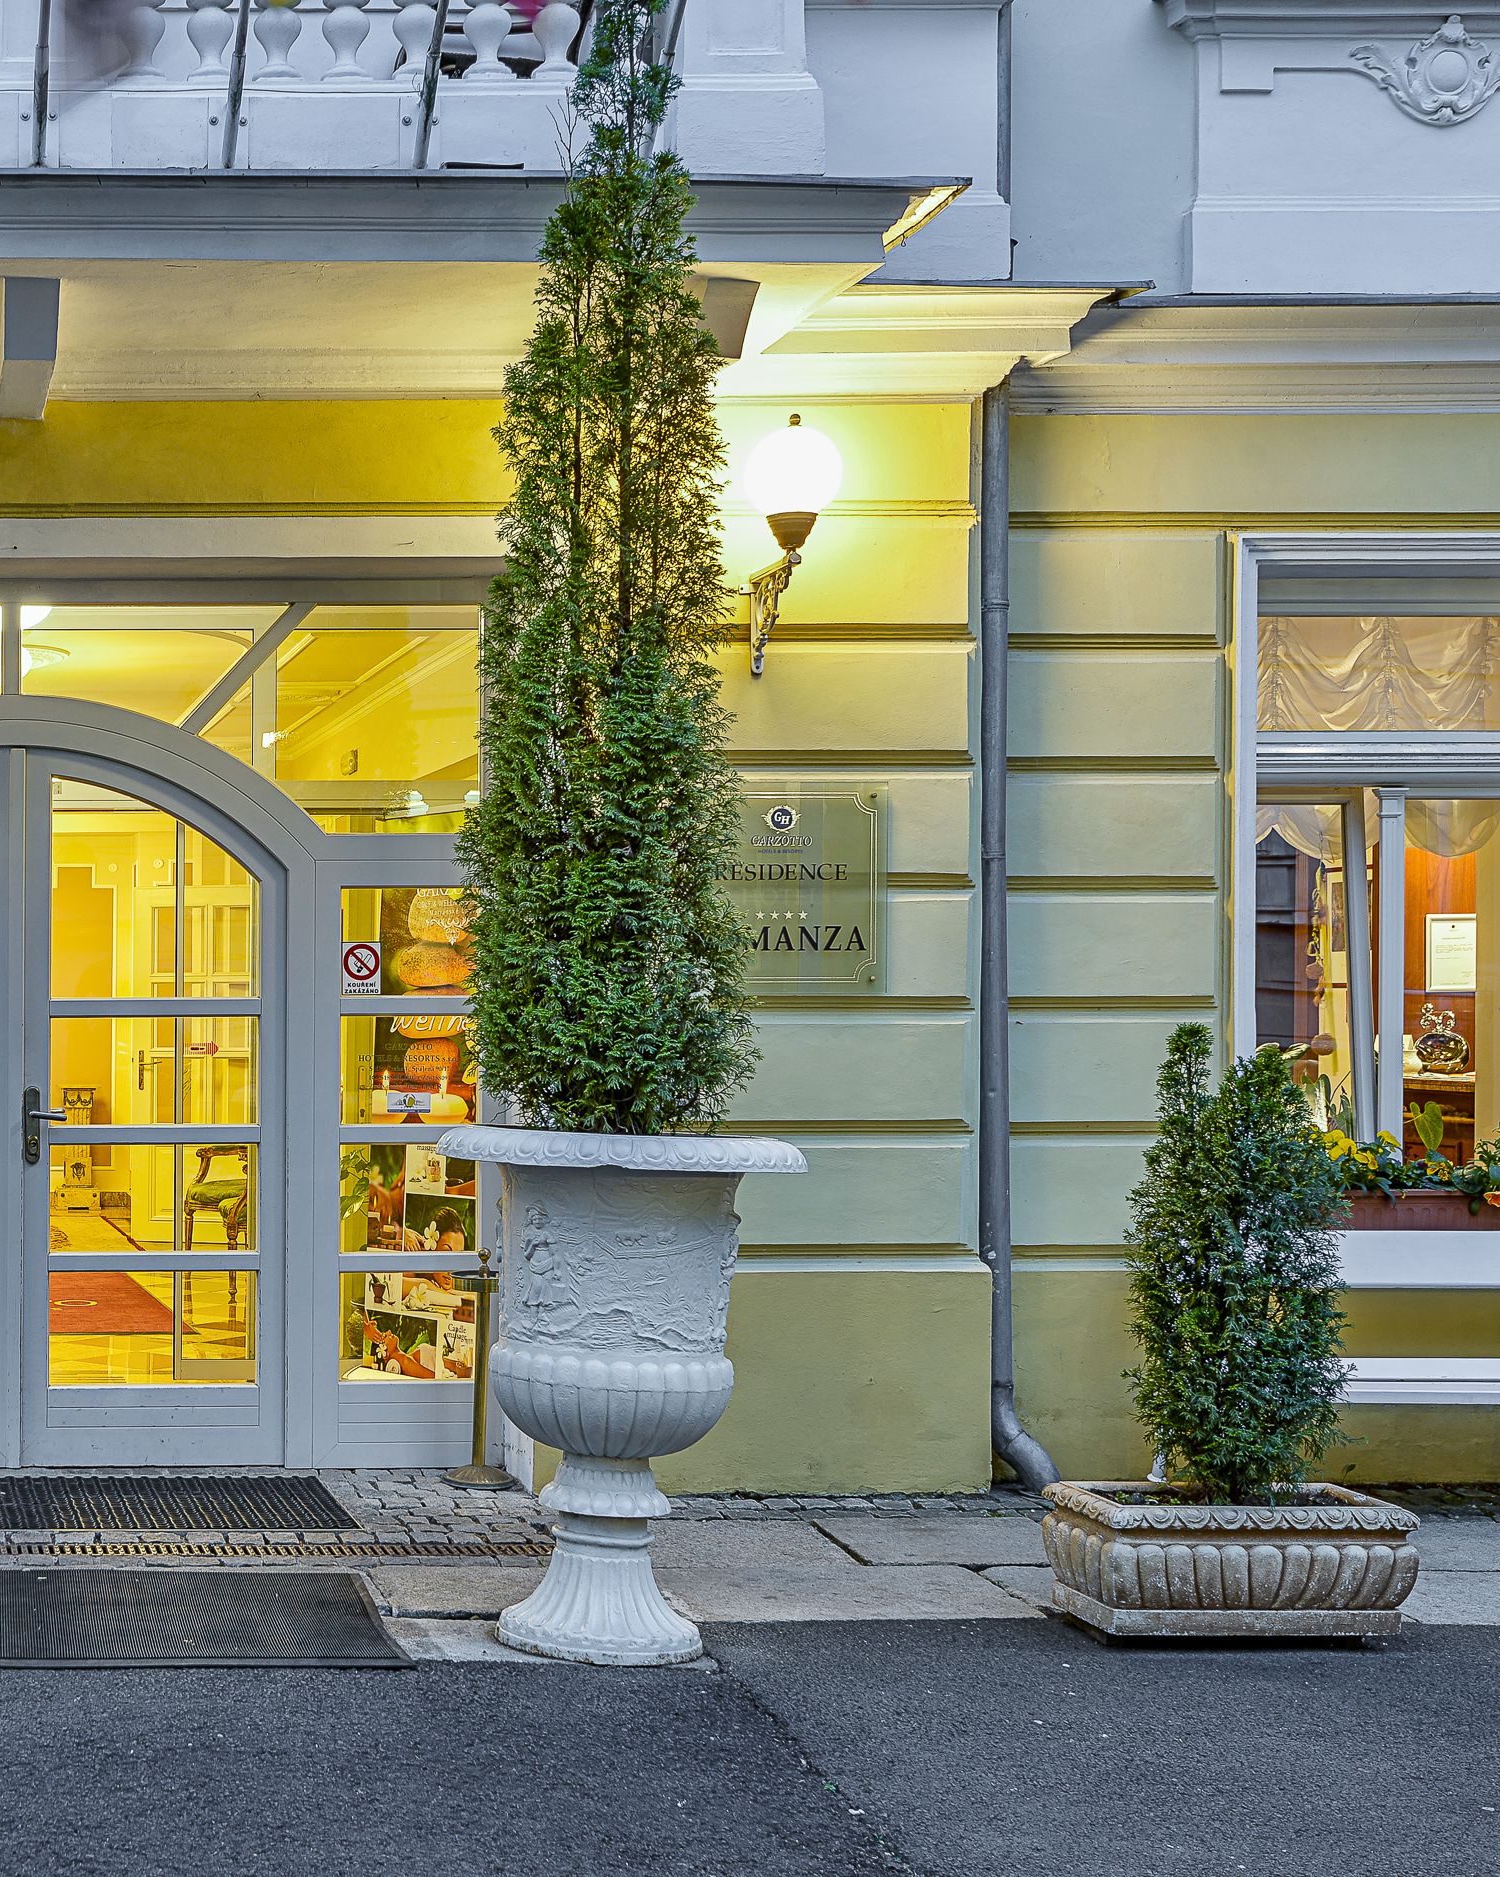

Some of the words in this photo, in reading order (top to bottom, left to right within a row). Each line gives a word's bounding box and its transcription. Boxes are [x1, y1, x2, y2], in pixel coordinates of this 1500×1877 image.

[751, 835, 813, 847] GARZOTTO
[715, 863, 848, 881] RESIDENCE
[744, 925, 867, 951] MANZA
[403, 1054, 441, 1062] RESORTS
